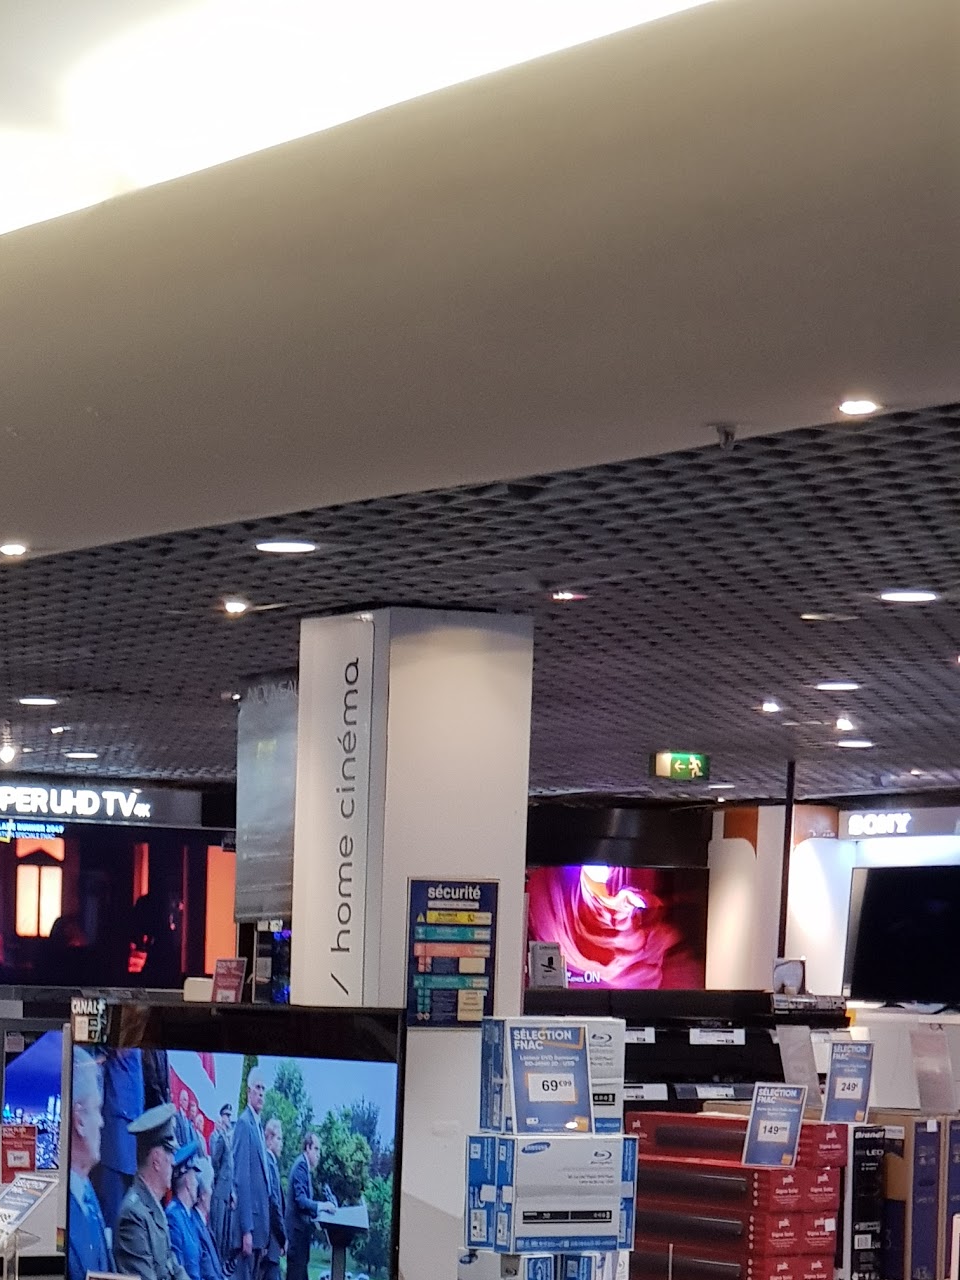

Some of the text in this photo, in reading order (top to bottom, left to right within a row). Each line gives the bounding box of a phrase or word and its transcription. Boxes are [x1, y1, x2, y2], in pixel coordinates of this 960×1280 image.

[336, 656, 360, 820] cinéma
[49, 788, 100, 816] UHD
[101, 790, 138, 818] TV
[848, 812, 912, 836] SONY
[330, 834, 355, 953] home
[427, 884, 482, 900] sécurité
[584, 971, 601, 983] ON
[71, 997, 106, 1016] CANAL+
[513, 1028, 572, 1041] SÉLECTION
[513, 1040, 544, 1051] FNAC
[756, 1096, 777, 1104] FNAC
[757, 1087, 797, 1098] SÉLECTION
